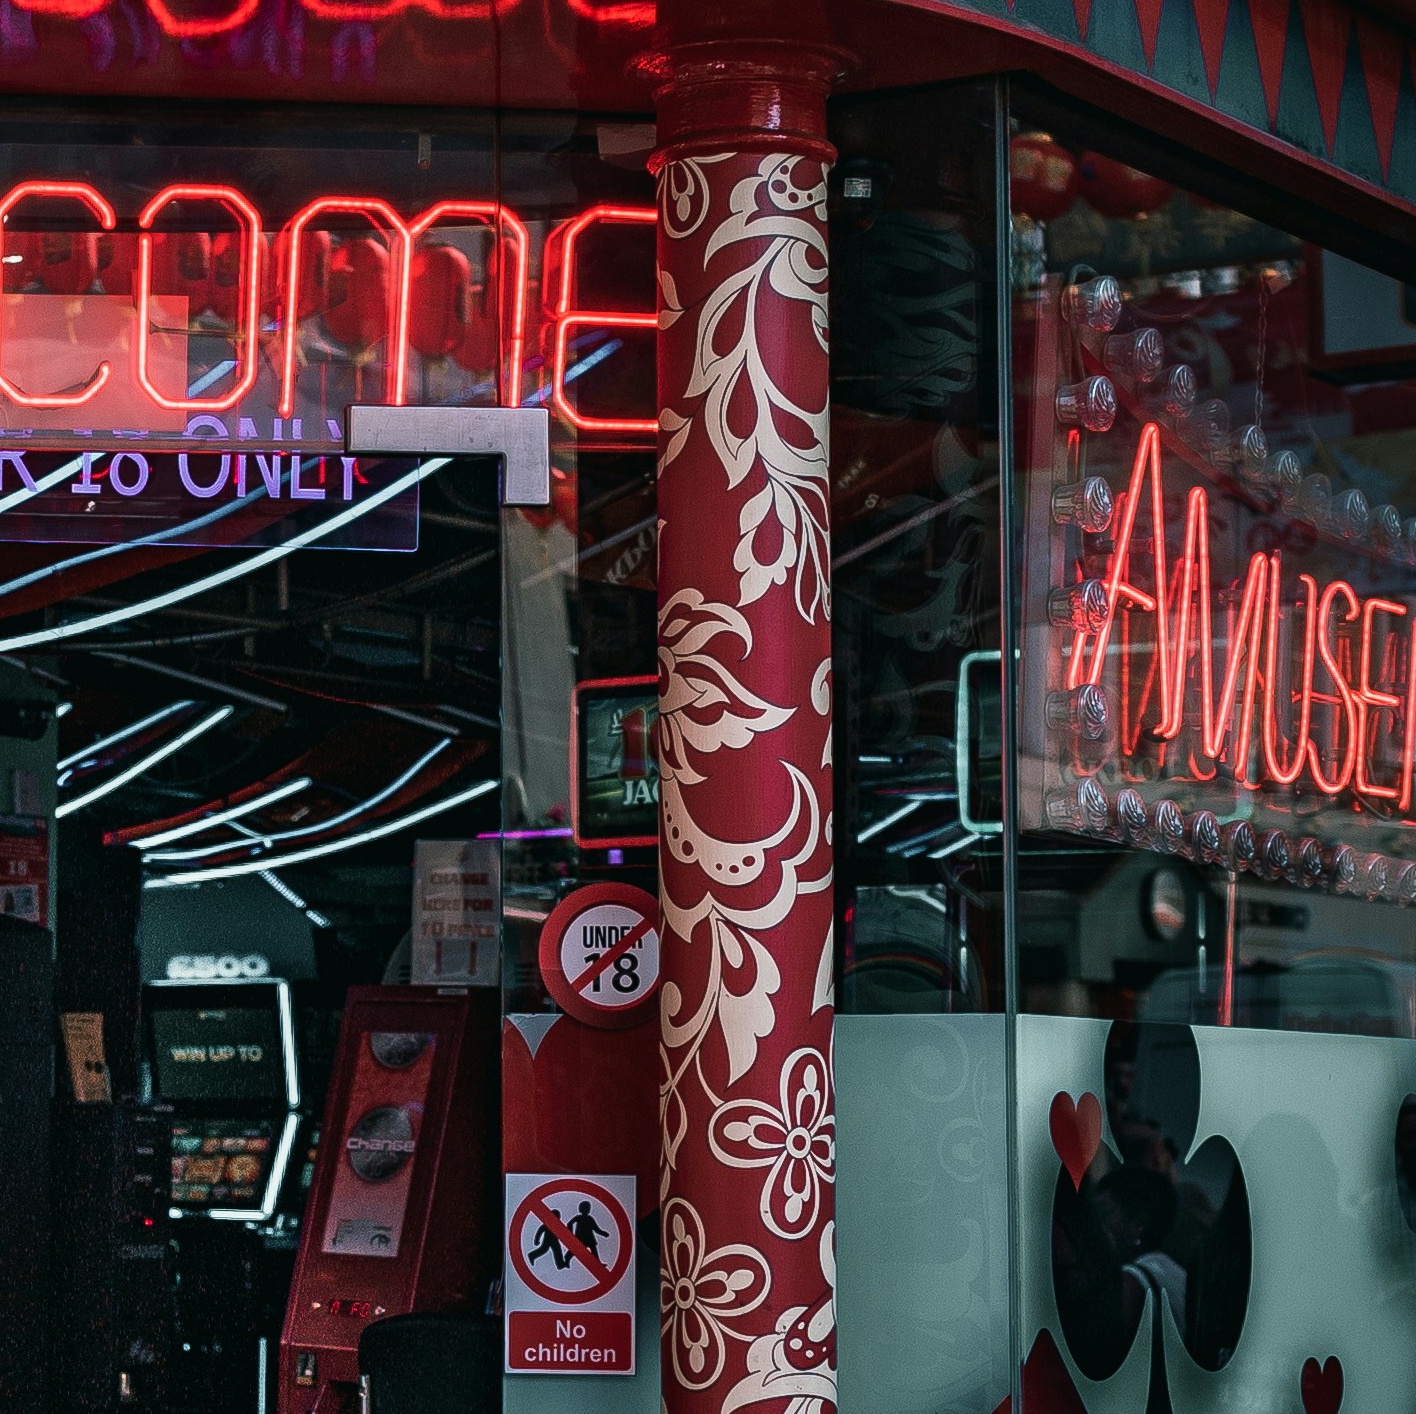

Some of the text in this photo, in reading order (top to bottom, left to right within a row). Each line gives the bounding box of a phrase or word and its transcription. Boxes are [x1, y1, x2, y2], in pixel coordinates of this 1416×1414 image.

[70, 425, 150, 496] 18
[178, 415, 358, 501] ONLY
[581, 924, 645, 949] UNDER
[583, 952, 642, 994] 18
[555, 1320, 587, 1340] No
[524, 1343, 617, 1364] children
